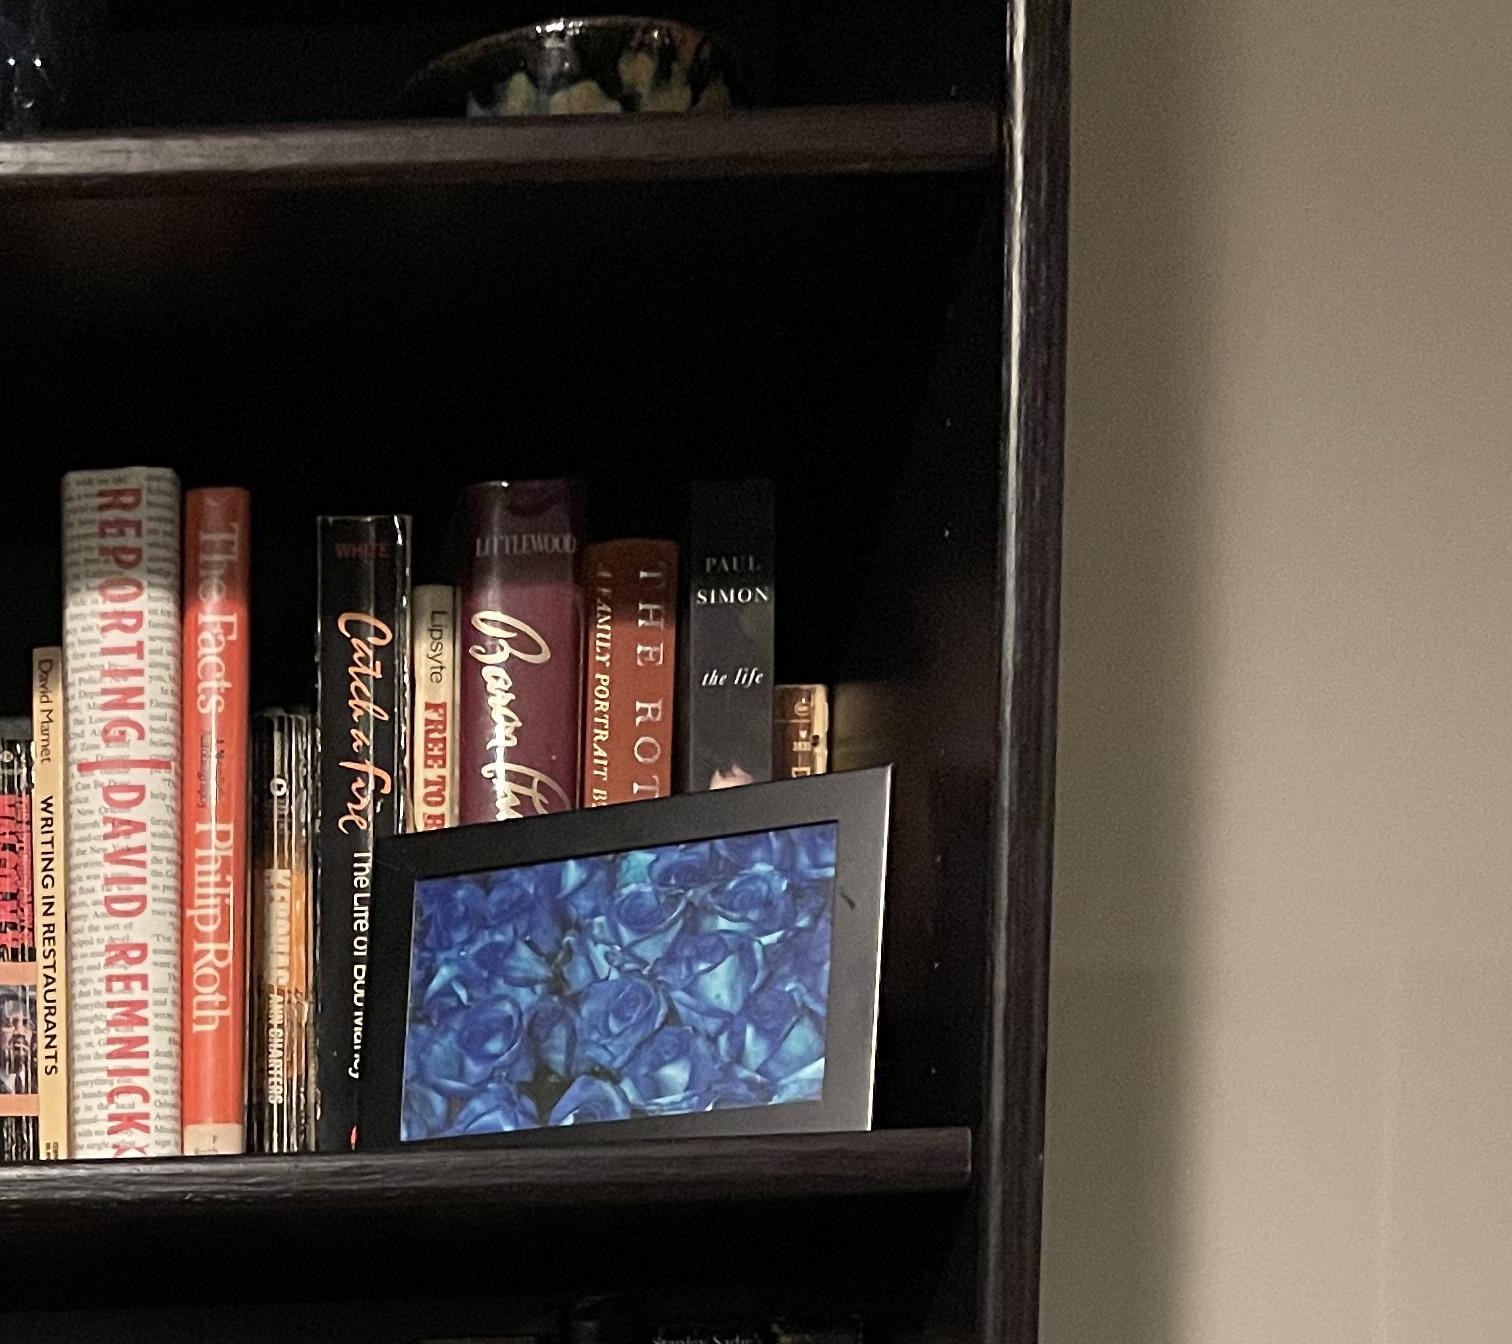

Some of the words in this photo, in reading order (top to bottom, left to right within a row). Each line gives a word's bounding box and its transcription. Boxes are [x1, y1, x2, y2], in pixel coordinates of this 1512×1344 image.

[97, 487, 146, 745] REPORTING
[696, 586, 769, 606] SIMON
[38, 659, 54, 704] David
[427, 610, 449, 685] Lipsyte
[39, 709, 54, 763] Mamet
[40, 796, 55, 890] WRITING
[102, 784, 149, 918] DAVID
[186, 821, 234, 930] Philip
[42, 895, 56, 916] IN
[42, 922, 58, 1077] RESTAURANTS
[191, 941, 234, 1033] Roth
[104, 942, 151, 1136] REMNICK
